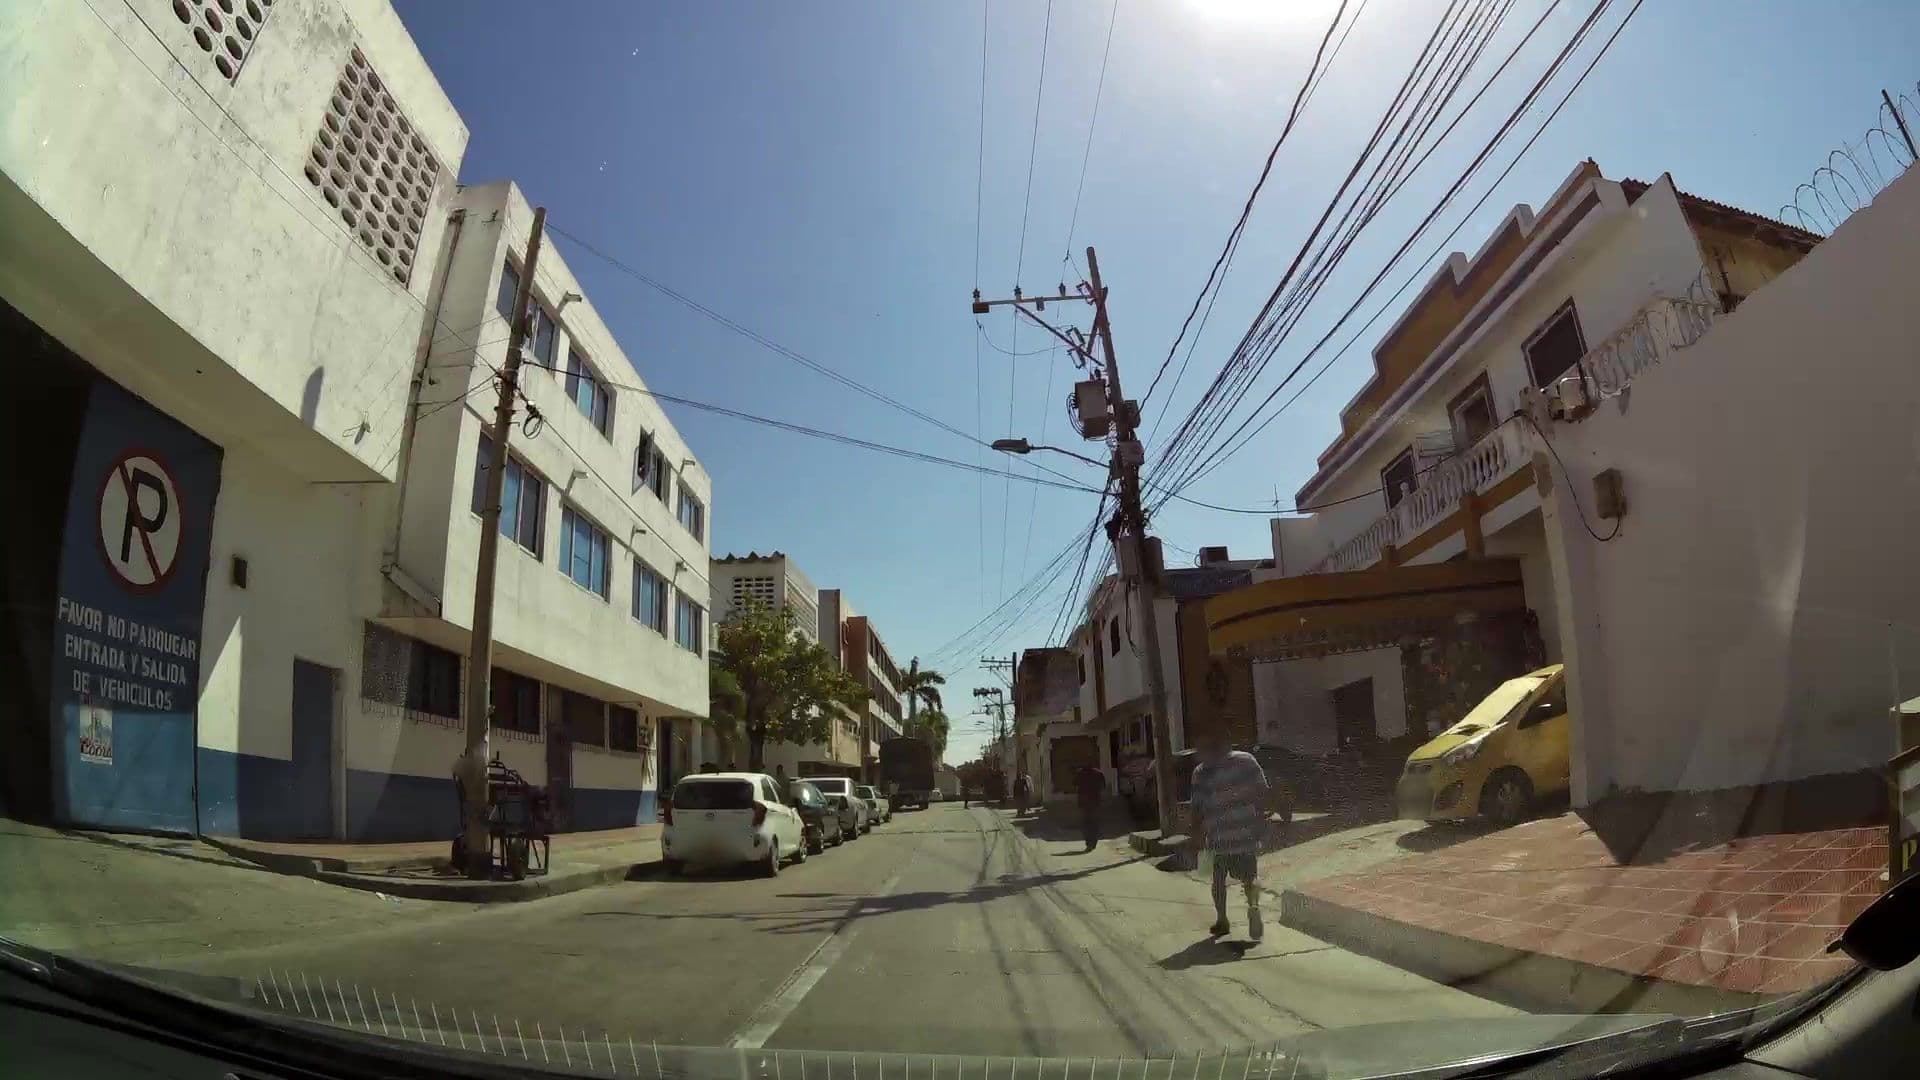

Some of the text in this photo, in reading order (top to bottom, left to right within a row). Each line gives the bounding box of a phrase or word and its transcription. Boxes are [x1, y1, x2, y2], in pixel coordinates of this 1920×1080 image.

[121, 467, 168, 563] P
[58, 597, 197, 661] FAVOR NO PARQUEAR
[65, 633, 187, 686] ENTRADA Y SALIDA
[73, 669, 173, 711] DE VEHICULOS
